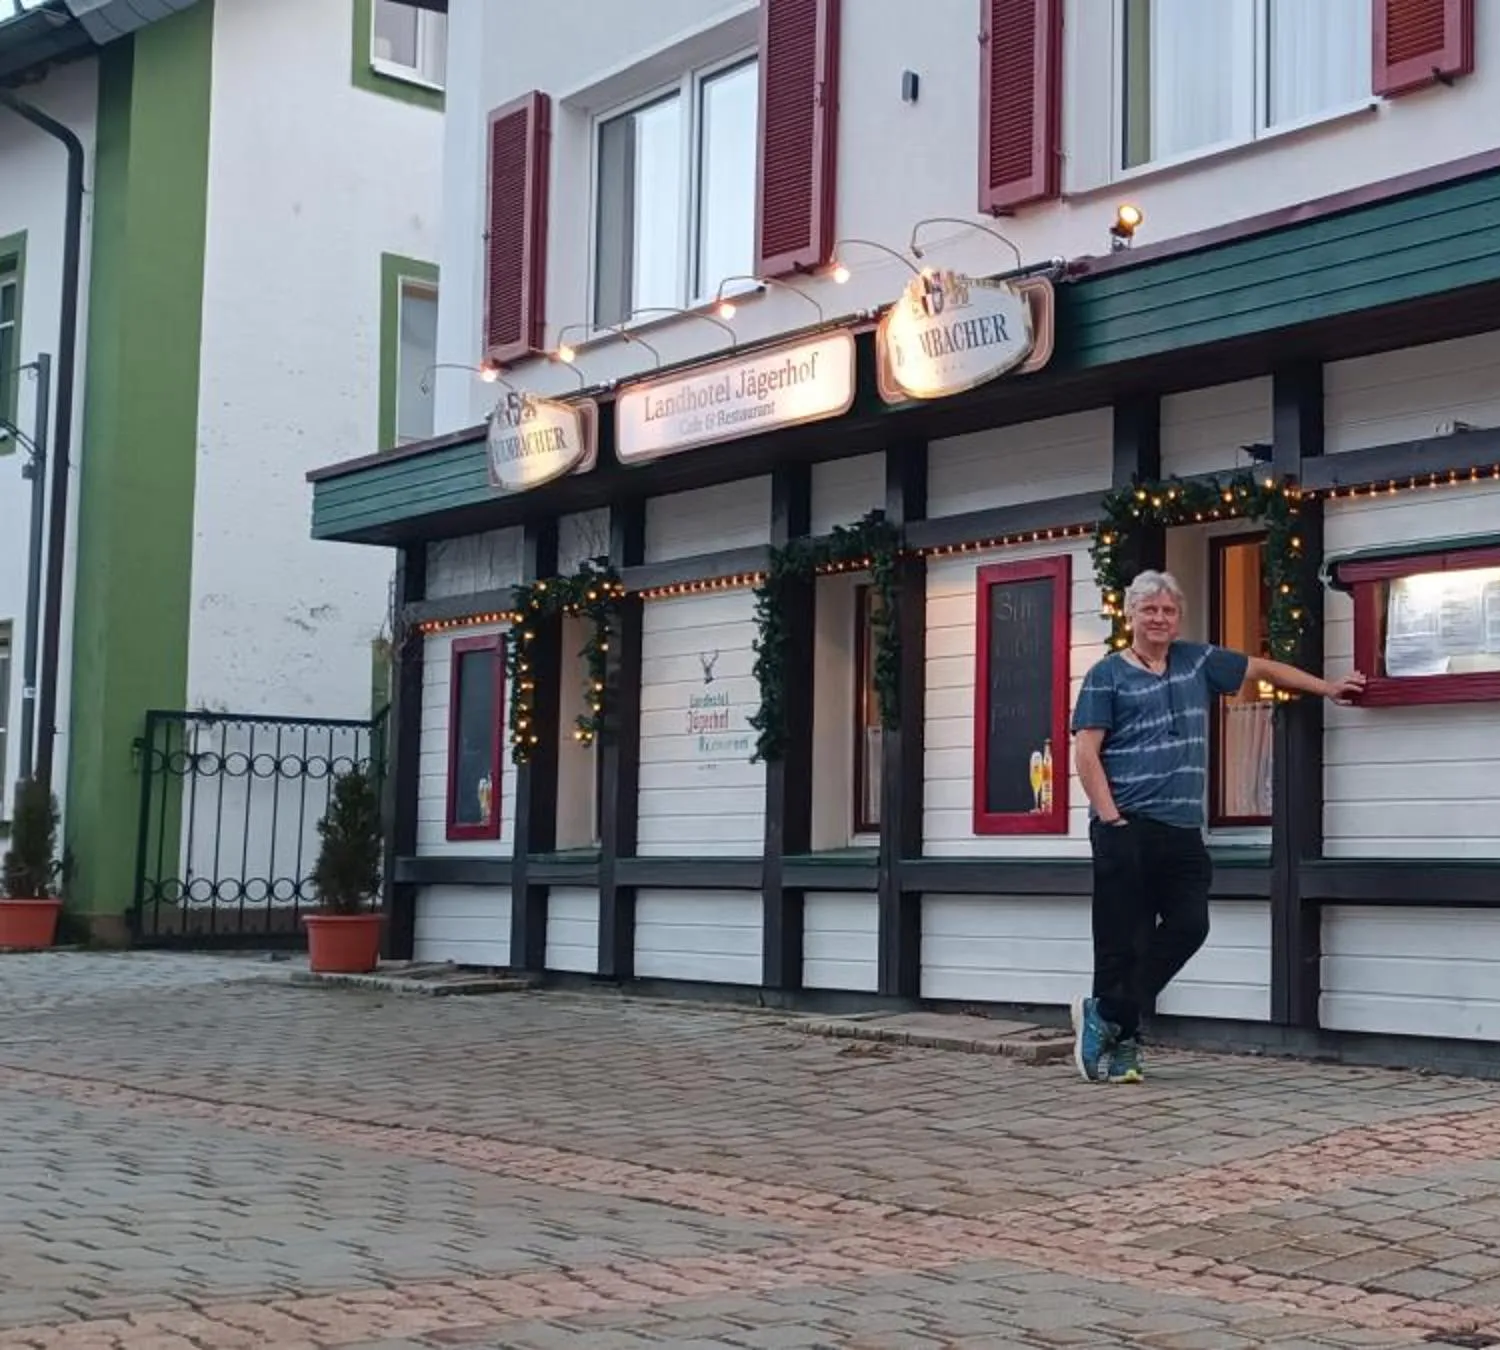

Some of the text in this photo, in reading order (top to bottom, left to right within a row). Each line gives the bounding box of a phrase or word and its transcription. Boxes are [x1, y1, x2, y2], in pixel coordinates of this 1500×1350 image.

[894, 313, 1010, 366] MBACHER
[644, 352, 818, 422] Landhotel Jägerhof
[717, 402, 776, 427] Restaurant
